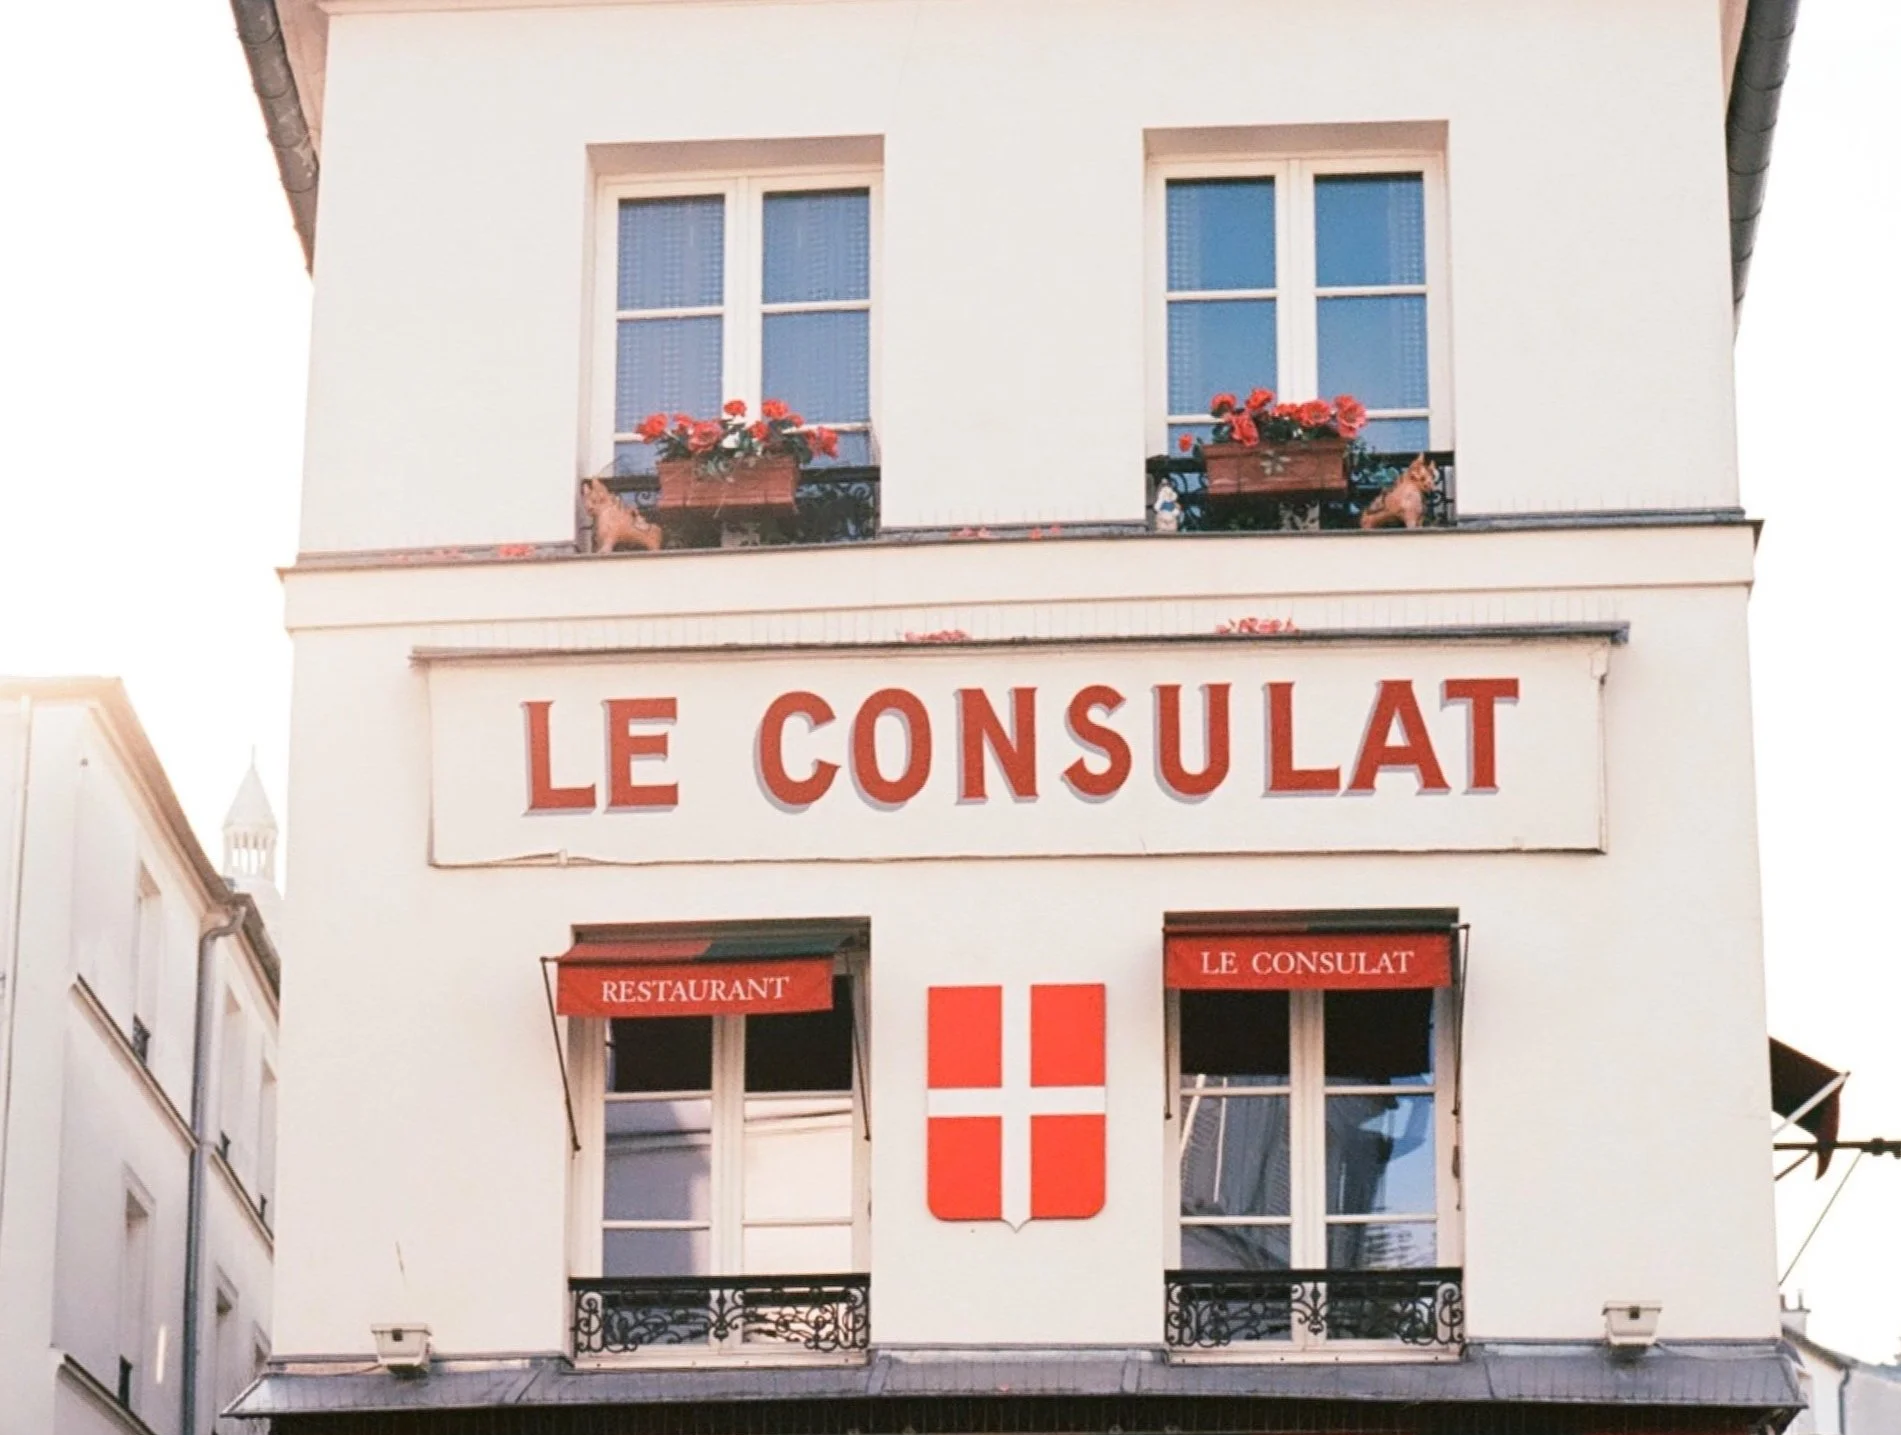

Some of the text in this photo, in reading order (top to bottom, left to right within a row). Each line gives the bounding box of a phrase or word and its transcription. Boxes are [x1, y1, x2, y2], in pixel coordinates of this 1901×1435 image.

[524, 678, 1520, 811] LE CONSULAT
[1201, 951, 1415, 975] LE CONSULAT
[601, 976, 790, 1003] RESTAURANT
